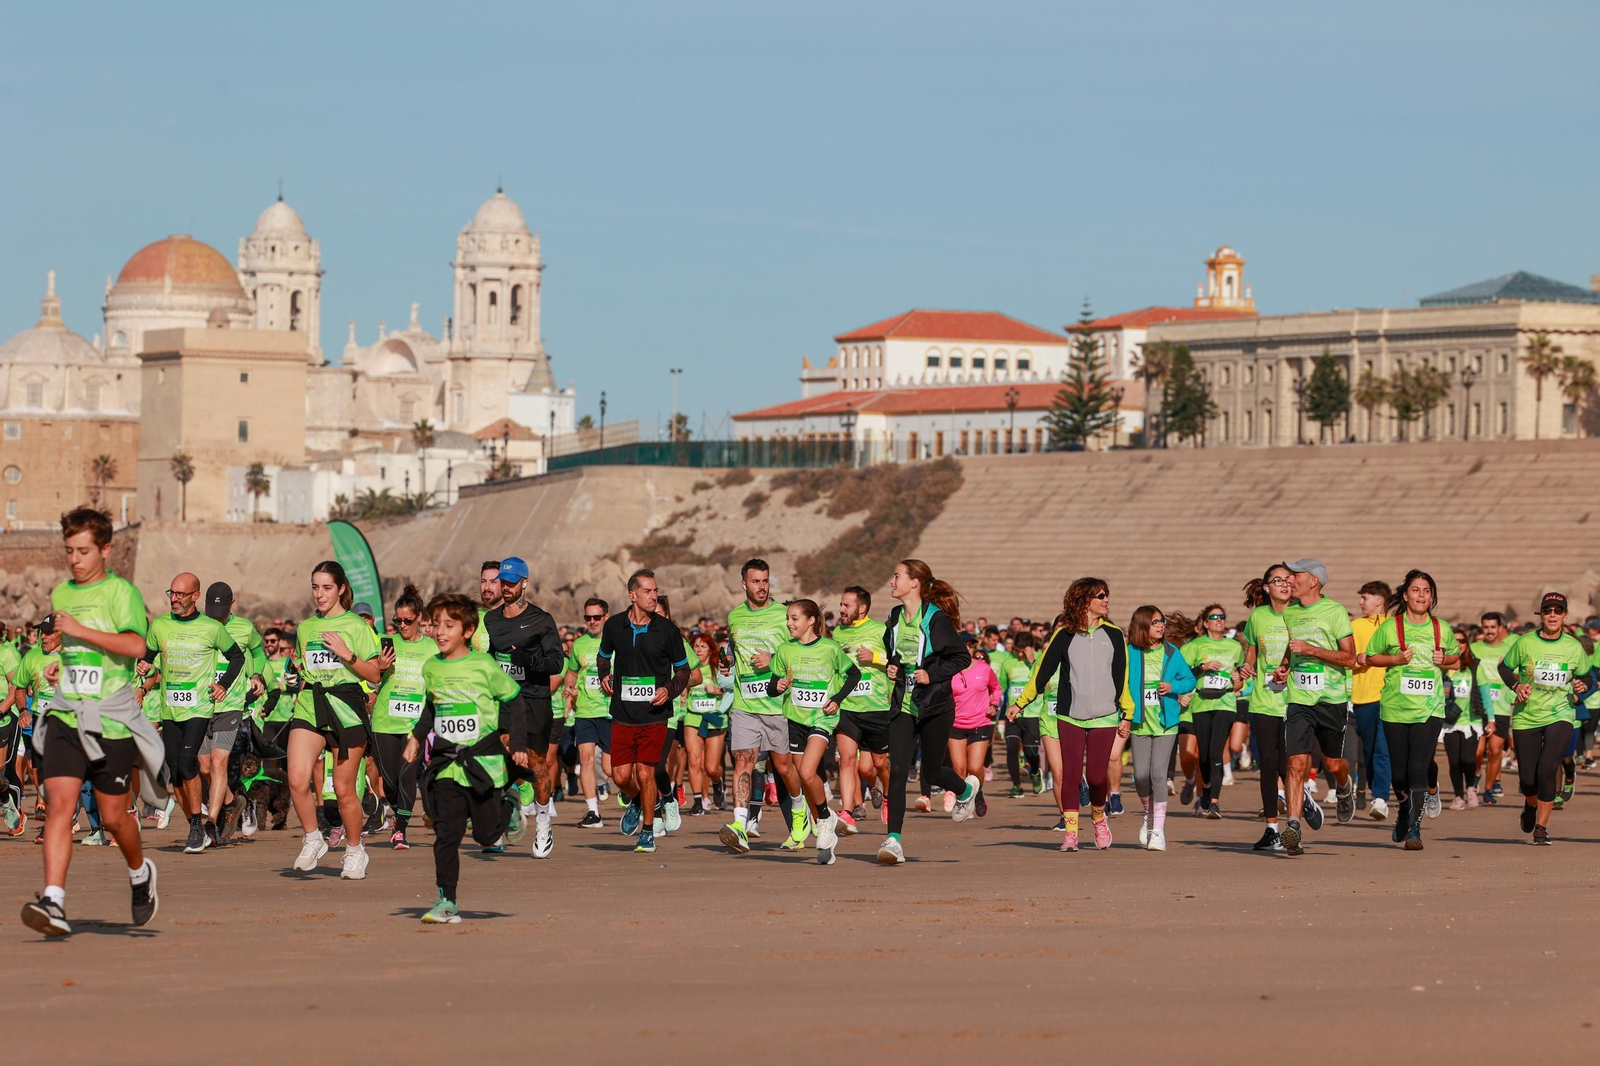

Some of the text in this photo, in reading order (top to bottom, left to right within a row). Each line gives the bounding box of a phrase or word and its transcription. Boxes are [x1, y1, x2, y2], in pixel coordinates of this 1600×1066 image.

[312, 652, 340, 664] 2312
[1209, 676, 1229, 687] 2717
[1300, 674, 1319, 685] 911
[1541, 671, 1566, 682] 2311
[1407, 679, 1434, 690] 5015
[173, 692, 192, 701] 938
[628, 686, 654, 697] 1209
[797, 690, 826, 702] 3337
[395, 702, 420, 714] 4154
[441, 718, 476, 734] 5069
